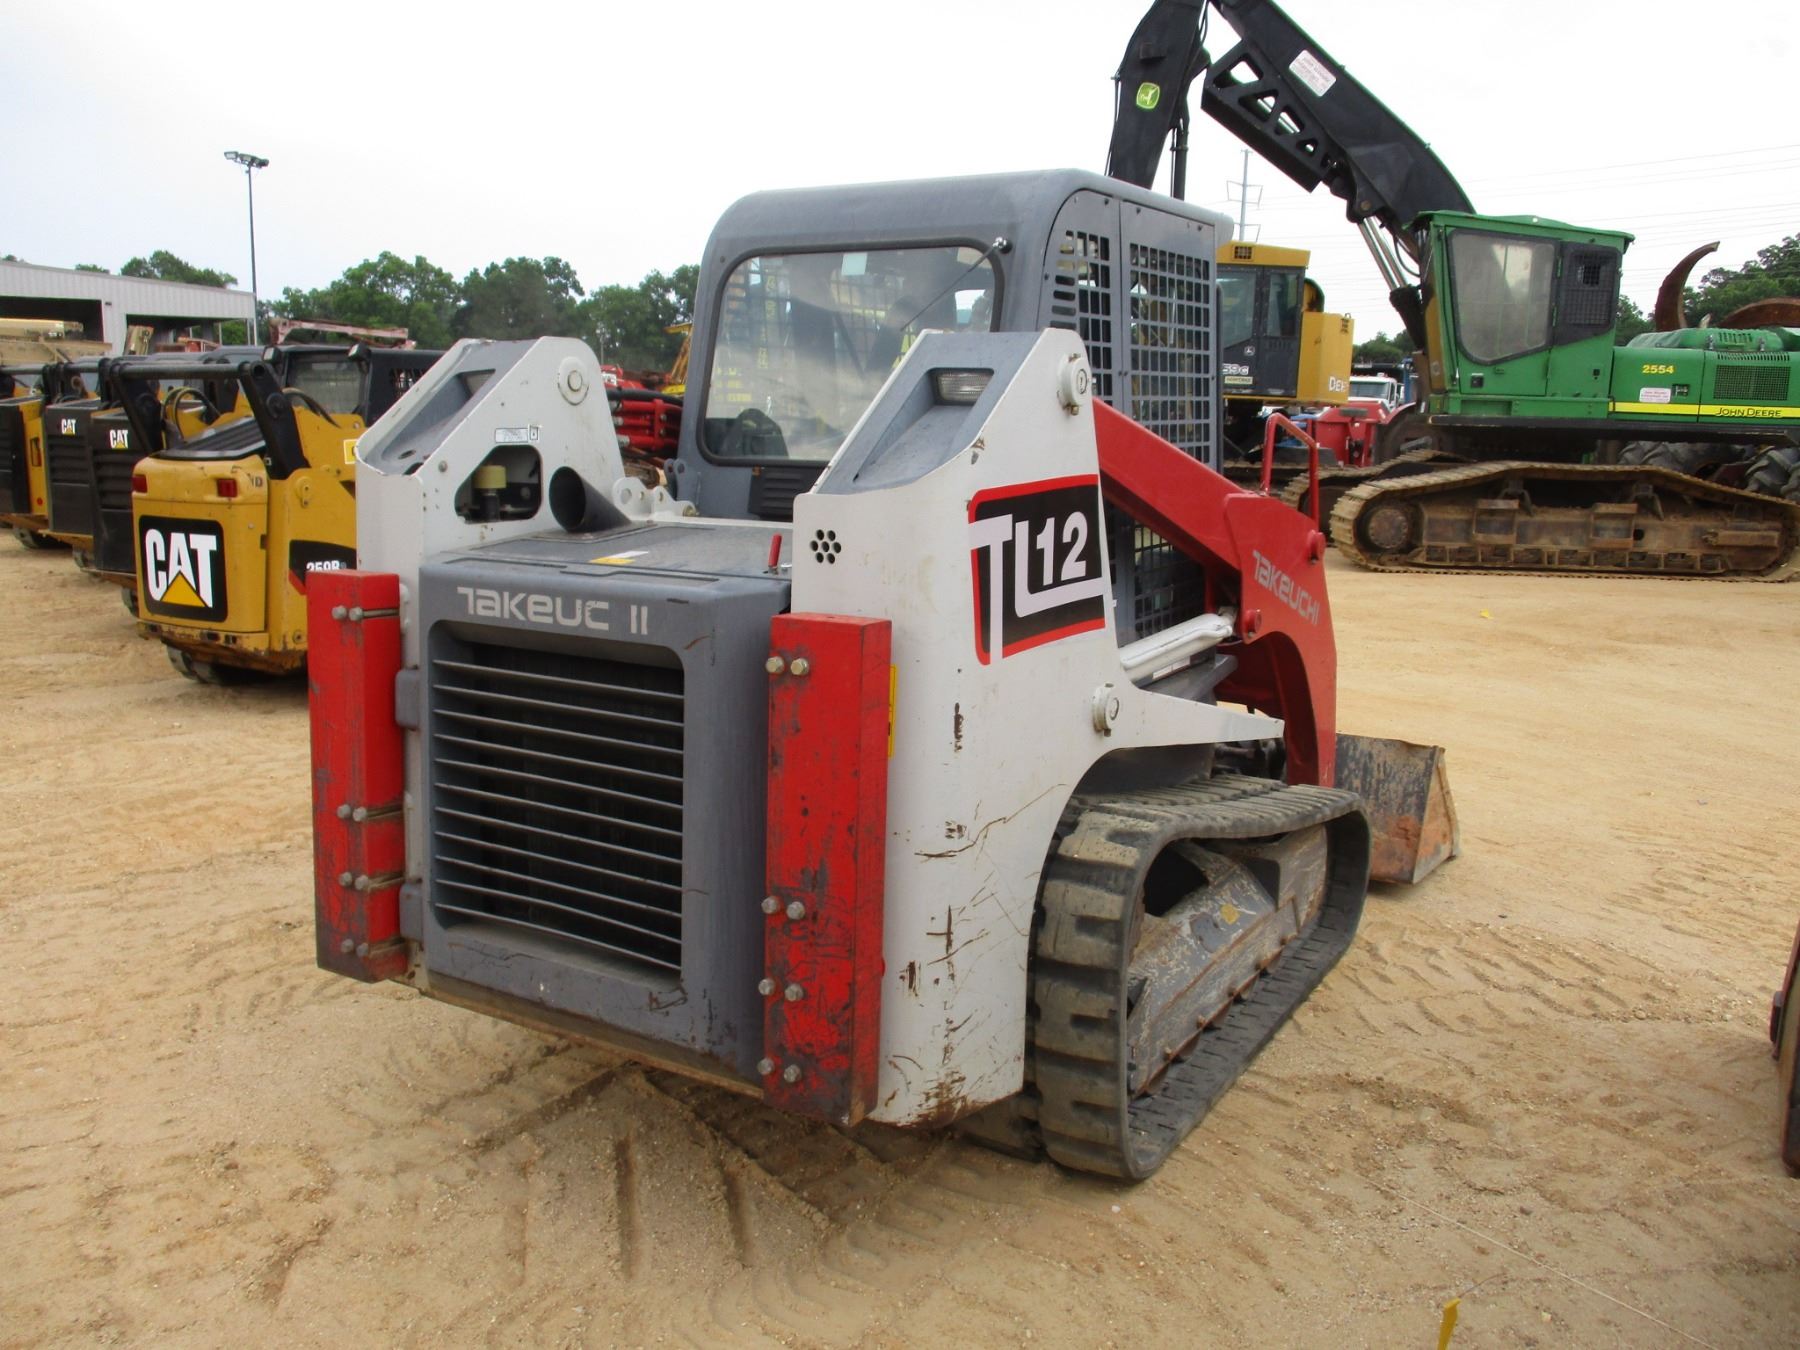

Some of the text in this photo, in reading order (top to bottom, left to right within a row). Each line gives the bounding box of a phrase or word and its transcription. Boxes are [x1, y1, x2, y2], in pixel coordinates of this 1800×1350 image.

[1642, 364, 1675, 375] 2554
[1715, 407, 1782, 418] JOHN DEERE
[61, 418, 76, 436] CAT
[109, 429, 129, 450] CAT
[145, 528, 217, 609] CAT
